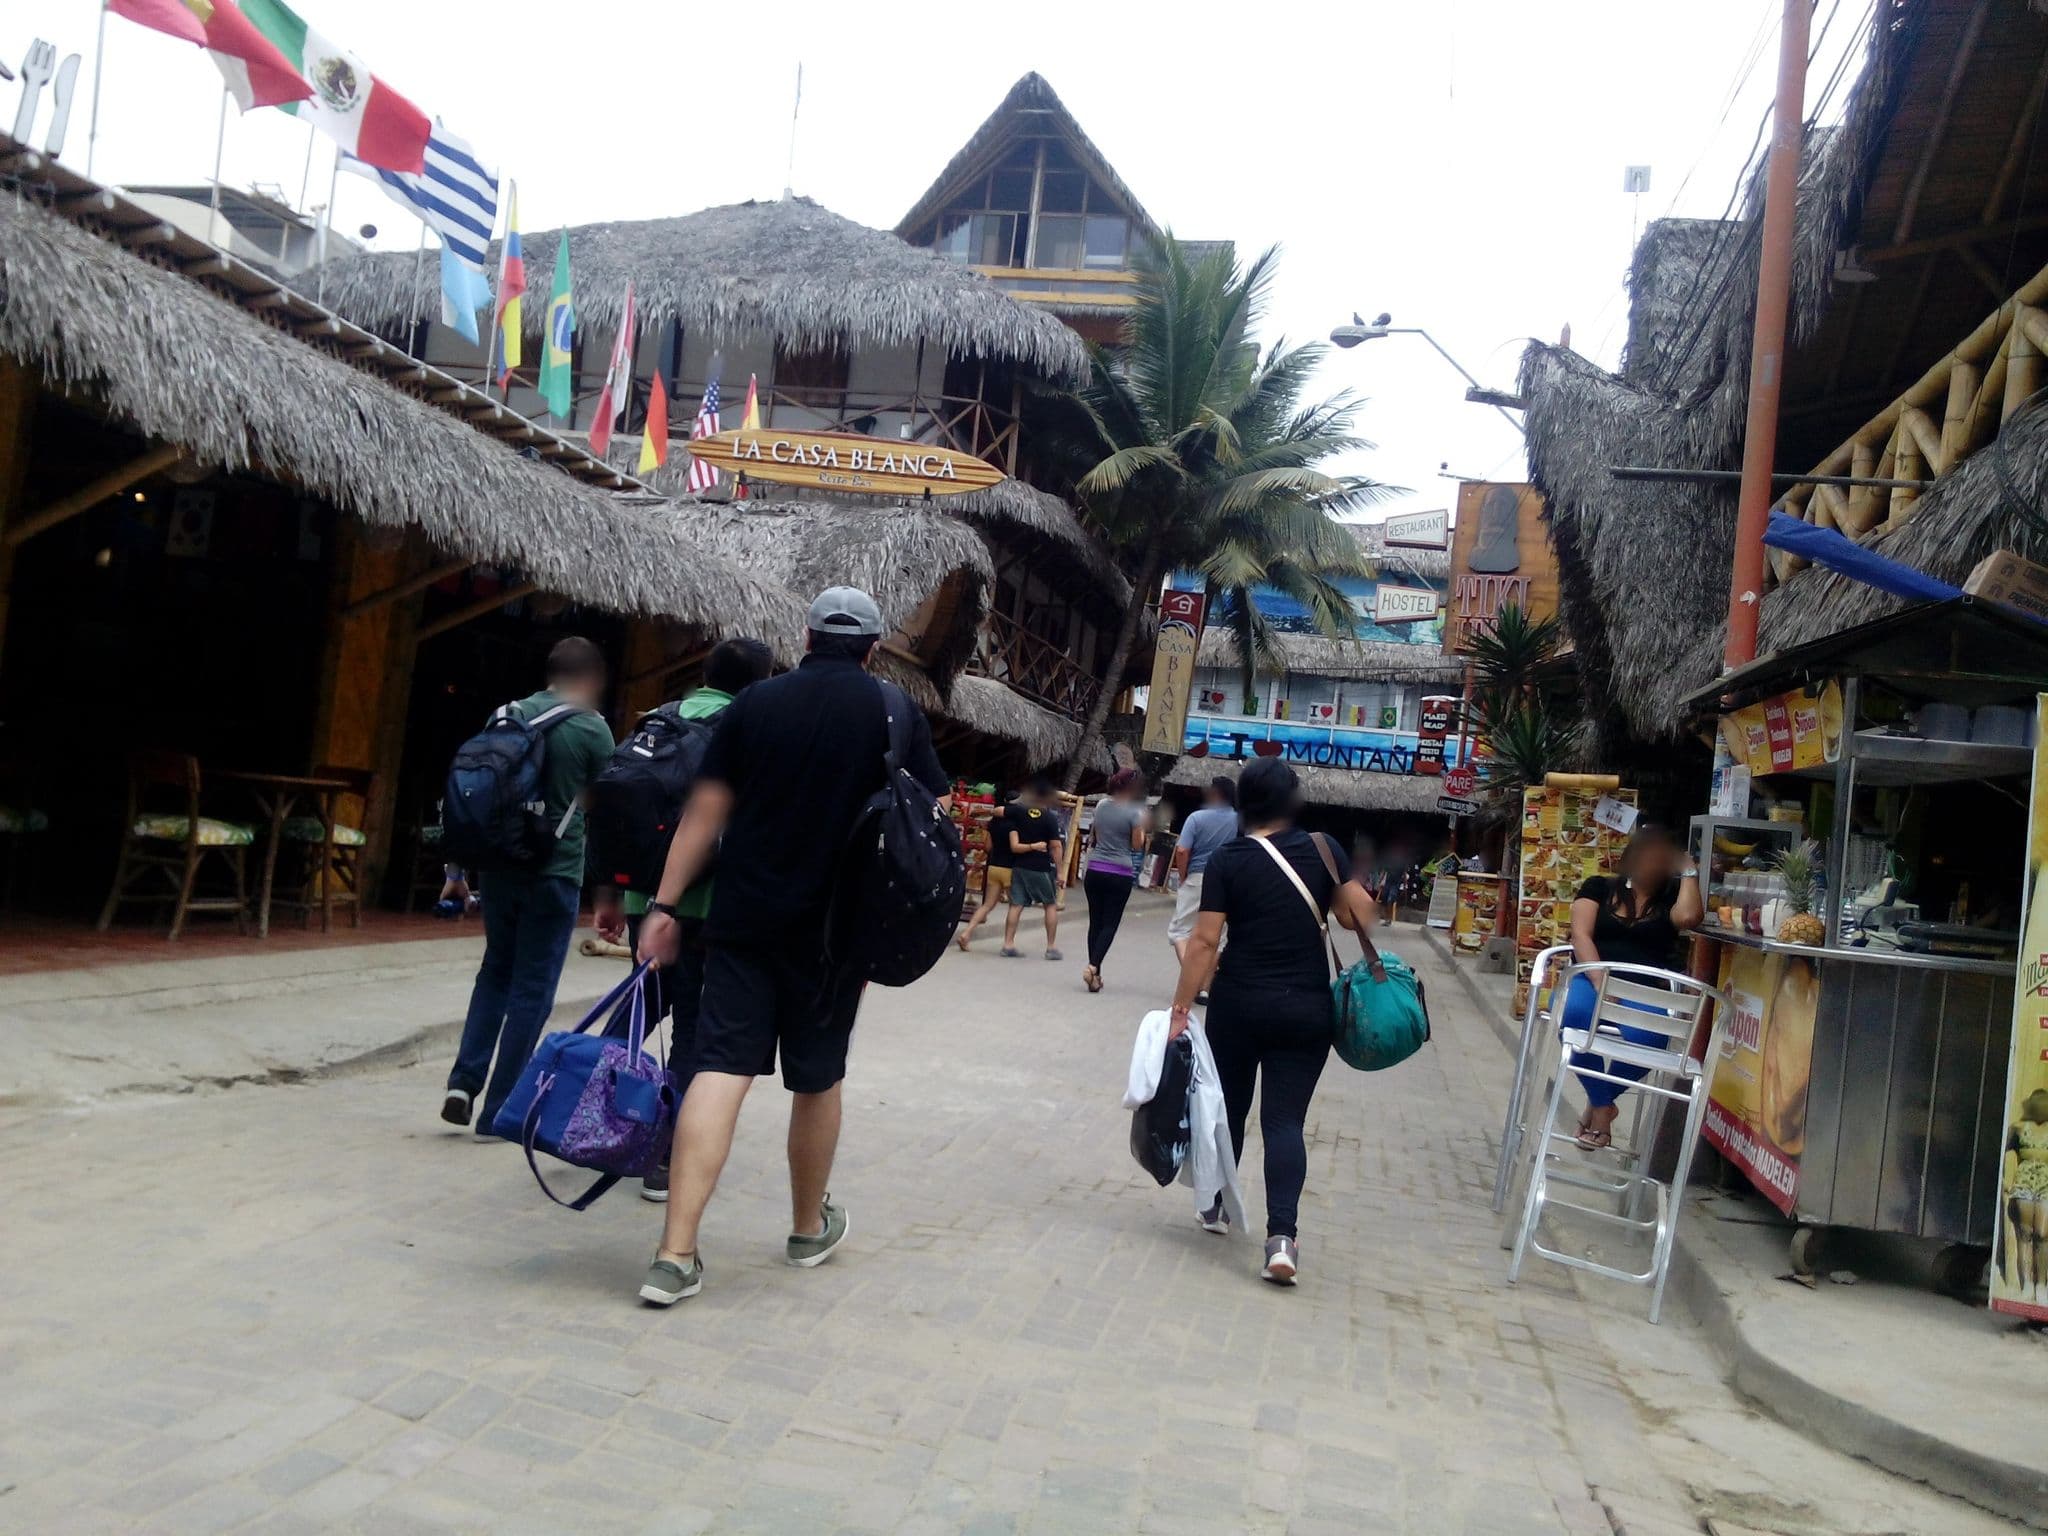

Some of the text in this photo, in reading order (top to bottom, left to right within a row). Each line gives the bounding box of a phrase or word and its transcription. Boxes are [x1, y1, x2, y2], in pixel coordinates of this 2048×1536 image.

[732, 436, 957, 479] LA CASA BLANCA
[1388, 516, 1444, 537] RESTAURANT
[1381, 593, 1433, 613] HOSTEL
[1455, 574, 1532, 619] TIKI
[1157, 655, 1179, 739] BLANCA
[1445, 775, 1472, 790] PARE
[1756, 1148, 1797, 1198] MADELEN
